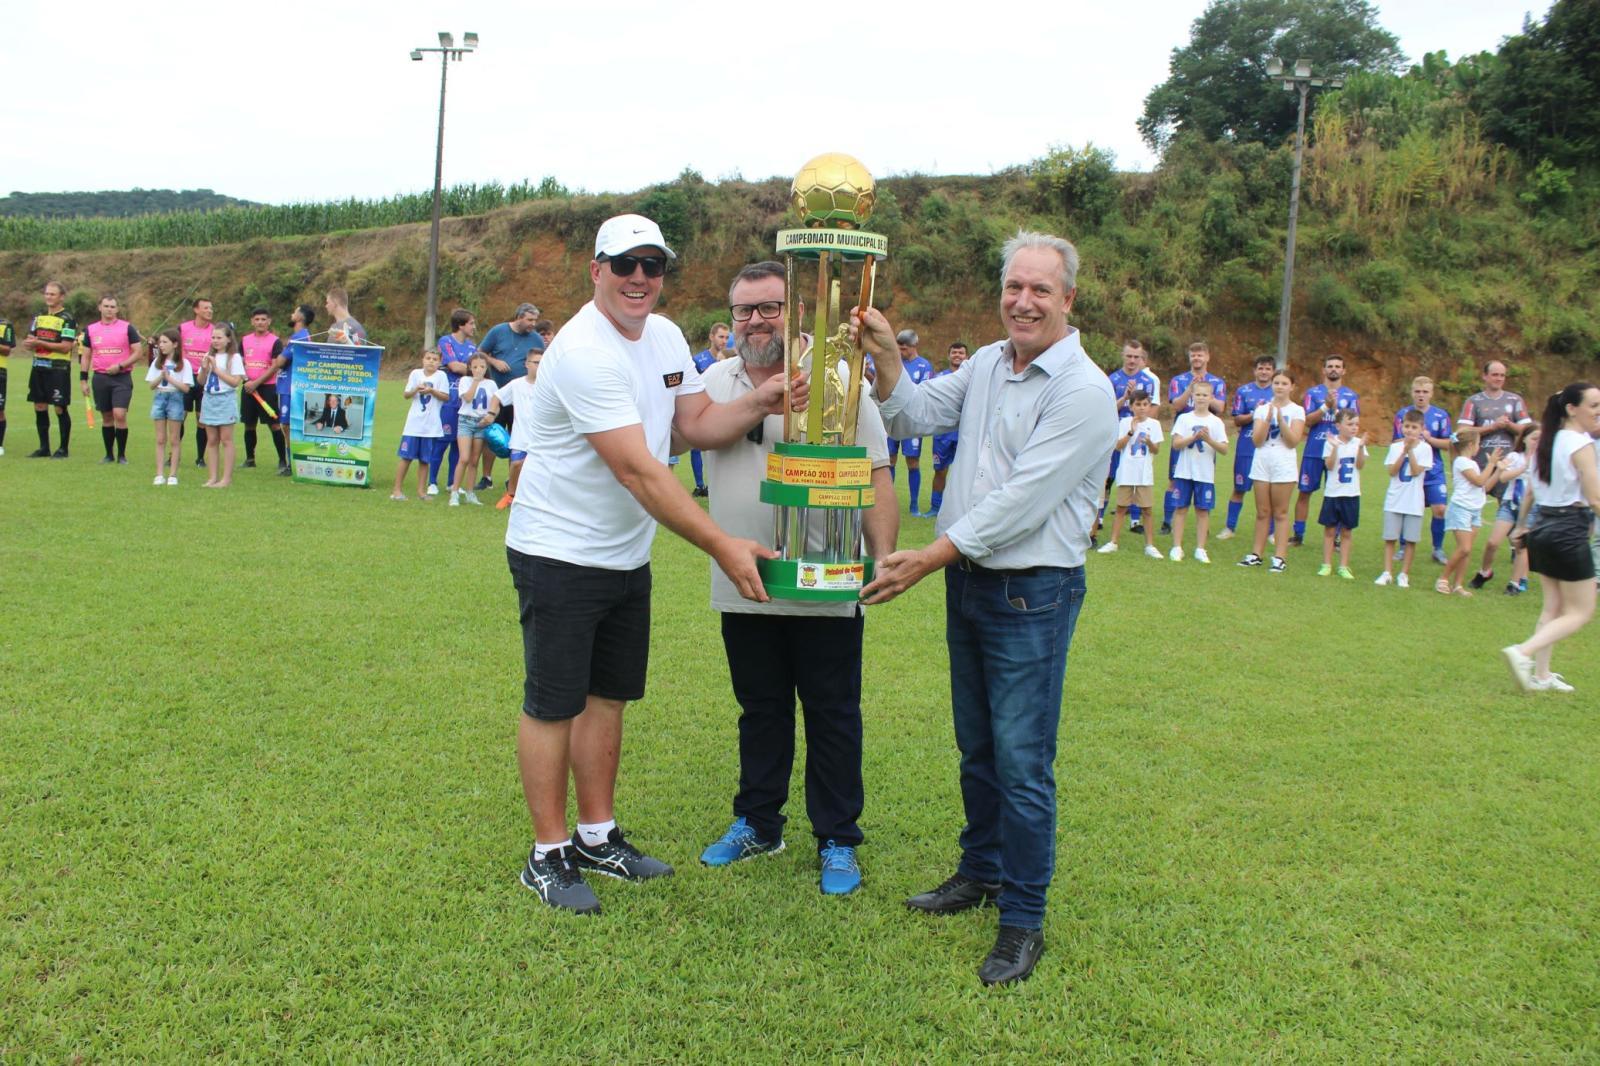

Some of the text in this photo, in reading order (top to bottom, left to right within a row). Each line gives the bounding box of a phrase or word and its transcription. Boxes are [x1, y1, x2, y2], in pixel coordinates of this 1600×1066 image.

[785, 233, 834, 245] CAMPEONATO
[836, 234, 876, 249] MUNICIPAL
[297, 367, 333, 375] MUNICIPAL
[344, 369, 373, 378] FUTEBOL
[318, 362, 364, 370] CAMPEONATO
[472, 387, 488, 409] A
[785, 469, 835, 479] CAMPEÃO 2013
[1338, 457, 1355, 483] E
